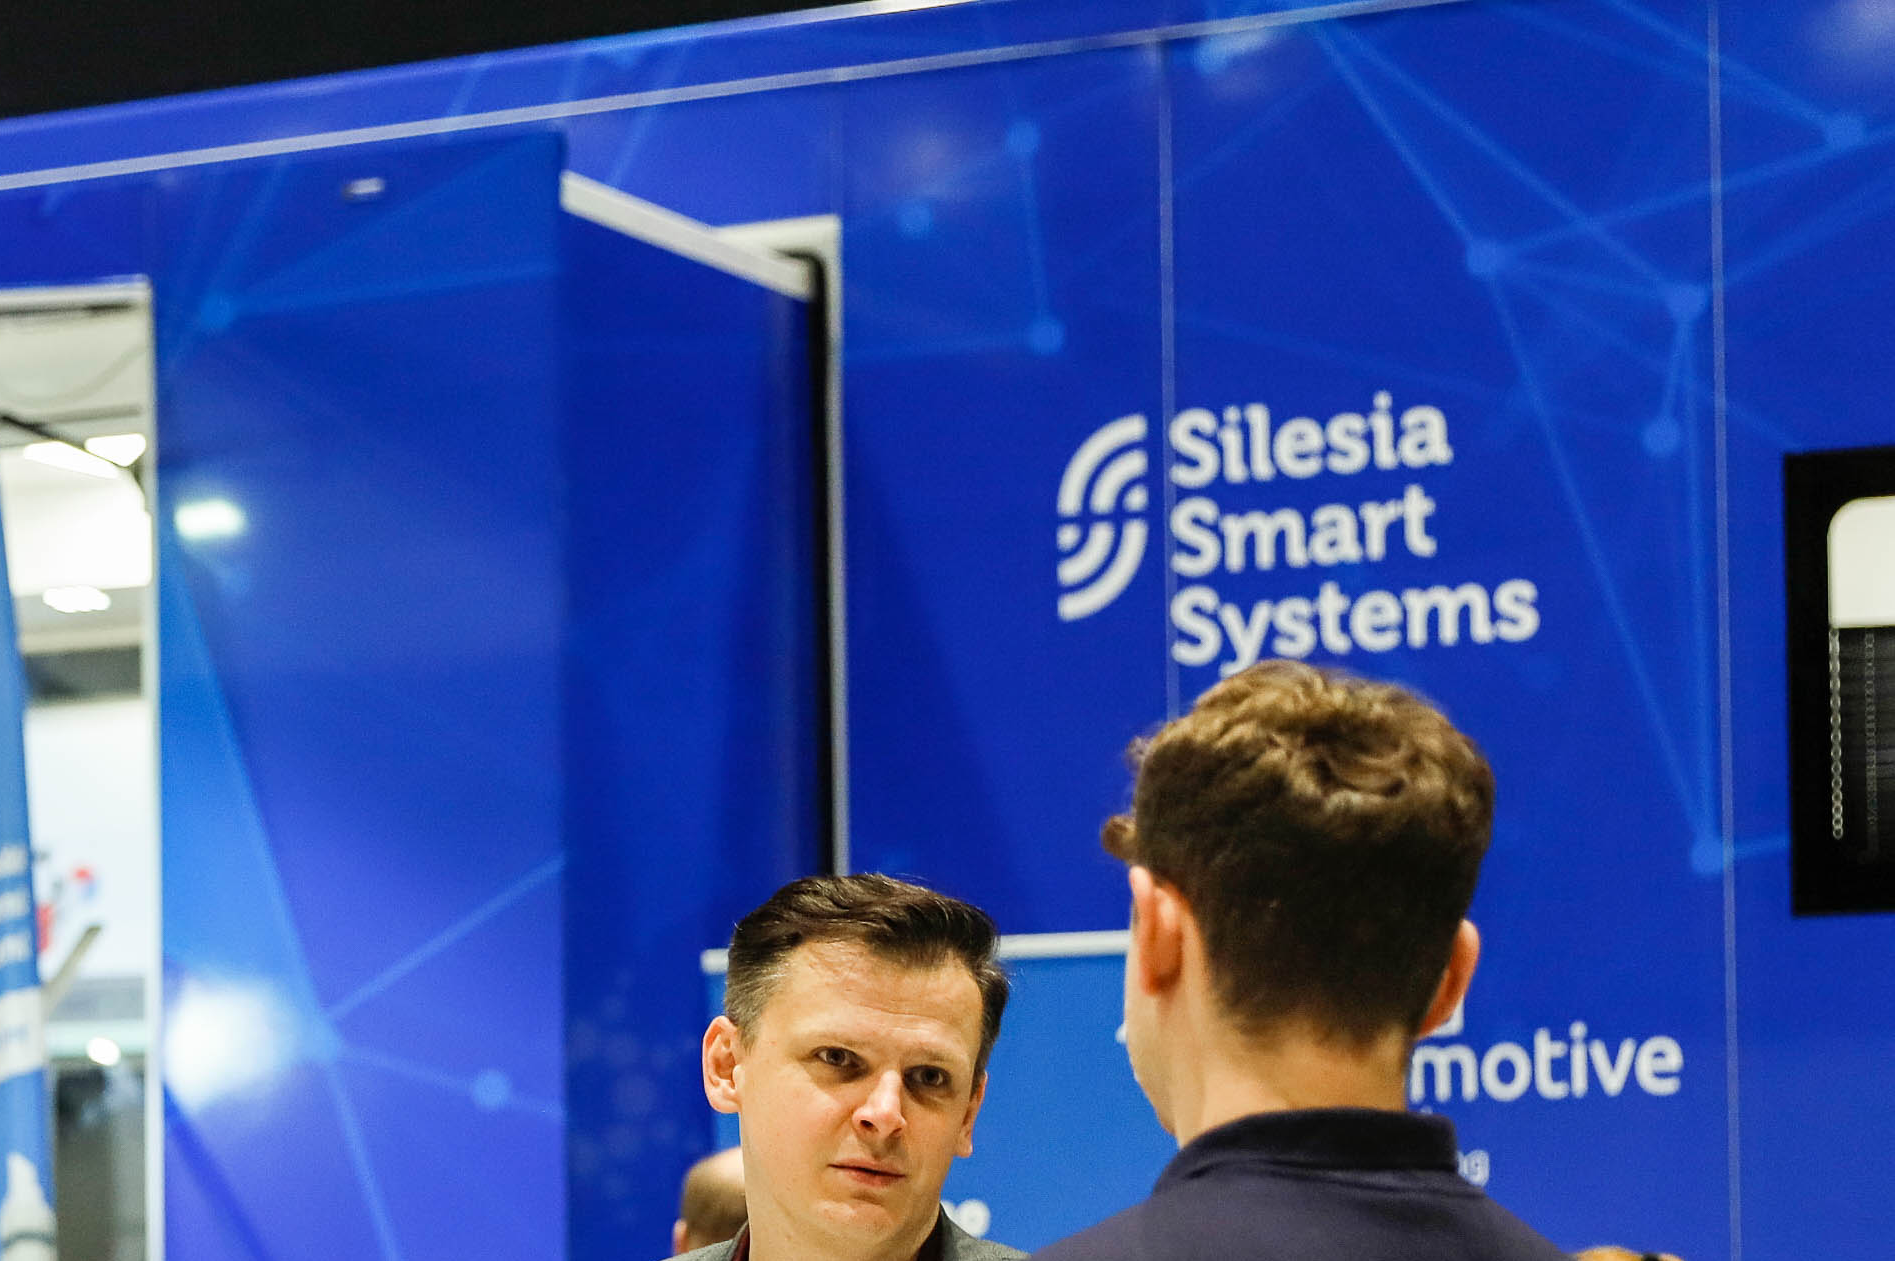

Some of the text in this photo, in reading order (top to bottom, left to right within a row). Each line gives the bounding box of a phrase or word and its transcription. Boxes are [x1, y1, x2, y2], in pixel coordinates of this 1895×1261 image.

[1168, 389, 1454, 489] Silesia
[1168, 483, 1438, 577] Smart
[1168, 578, 1541, 681] Systems
[1409, 1020, 1685, 1102] motive
